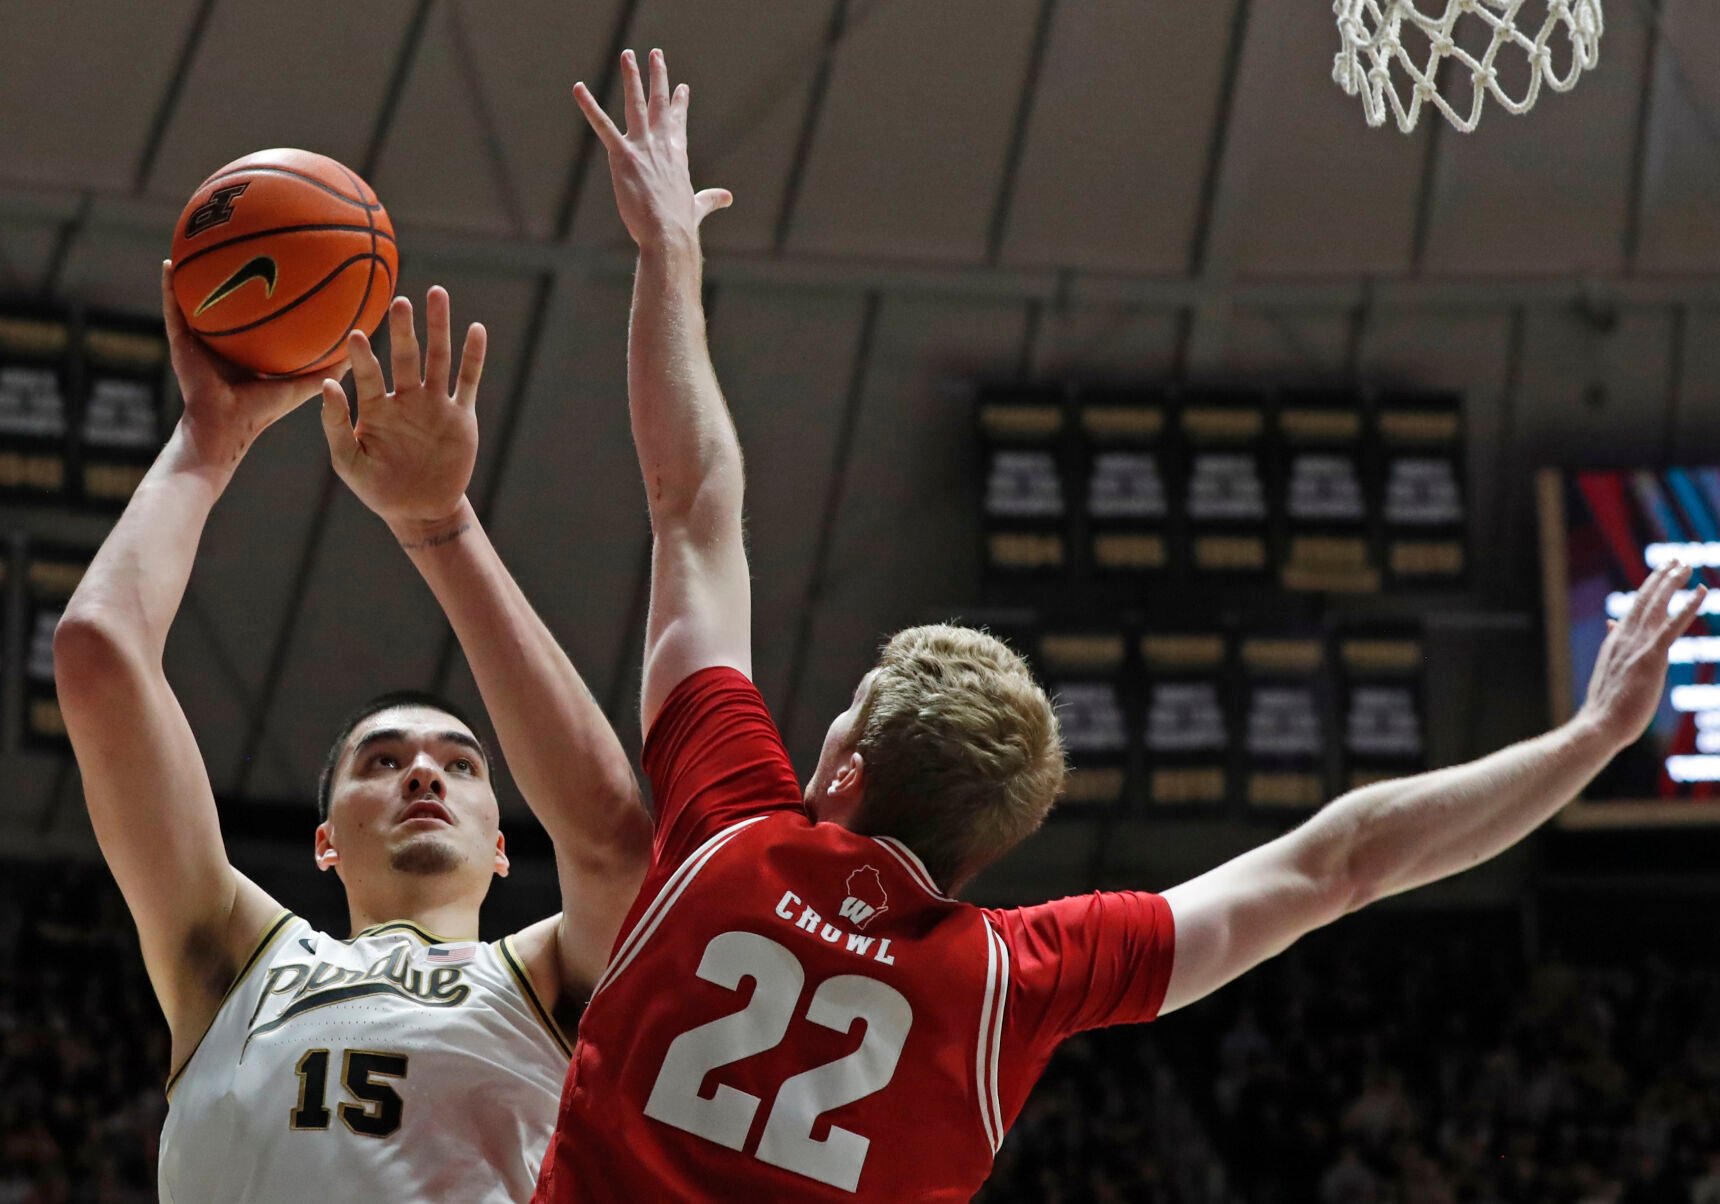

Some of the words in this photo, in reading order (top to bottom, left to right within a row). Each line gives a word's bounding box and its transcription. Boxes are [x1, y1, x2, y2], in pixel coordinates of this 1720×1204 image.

[774, 890, 896, 966] CROWL
[838, 896, 876, 926] W
[246, 945, 472, 1036] Purdue
[289, 1047, 409, 1139] 15
[643, 931, 913, 1194] 22
